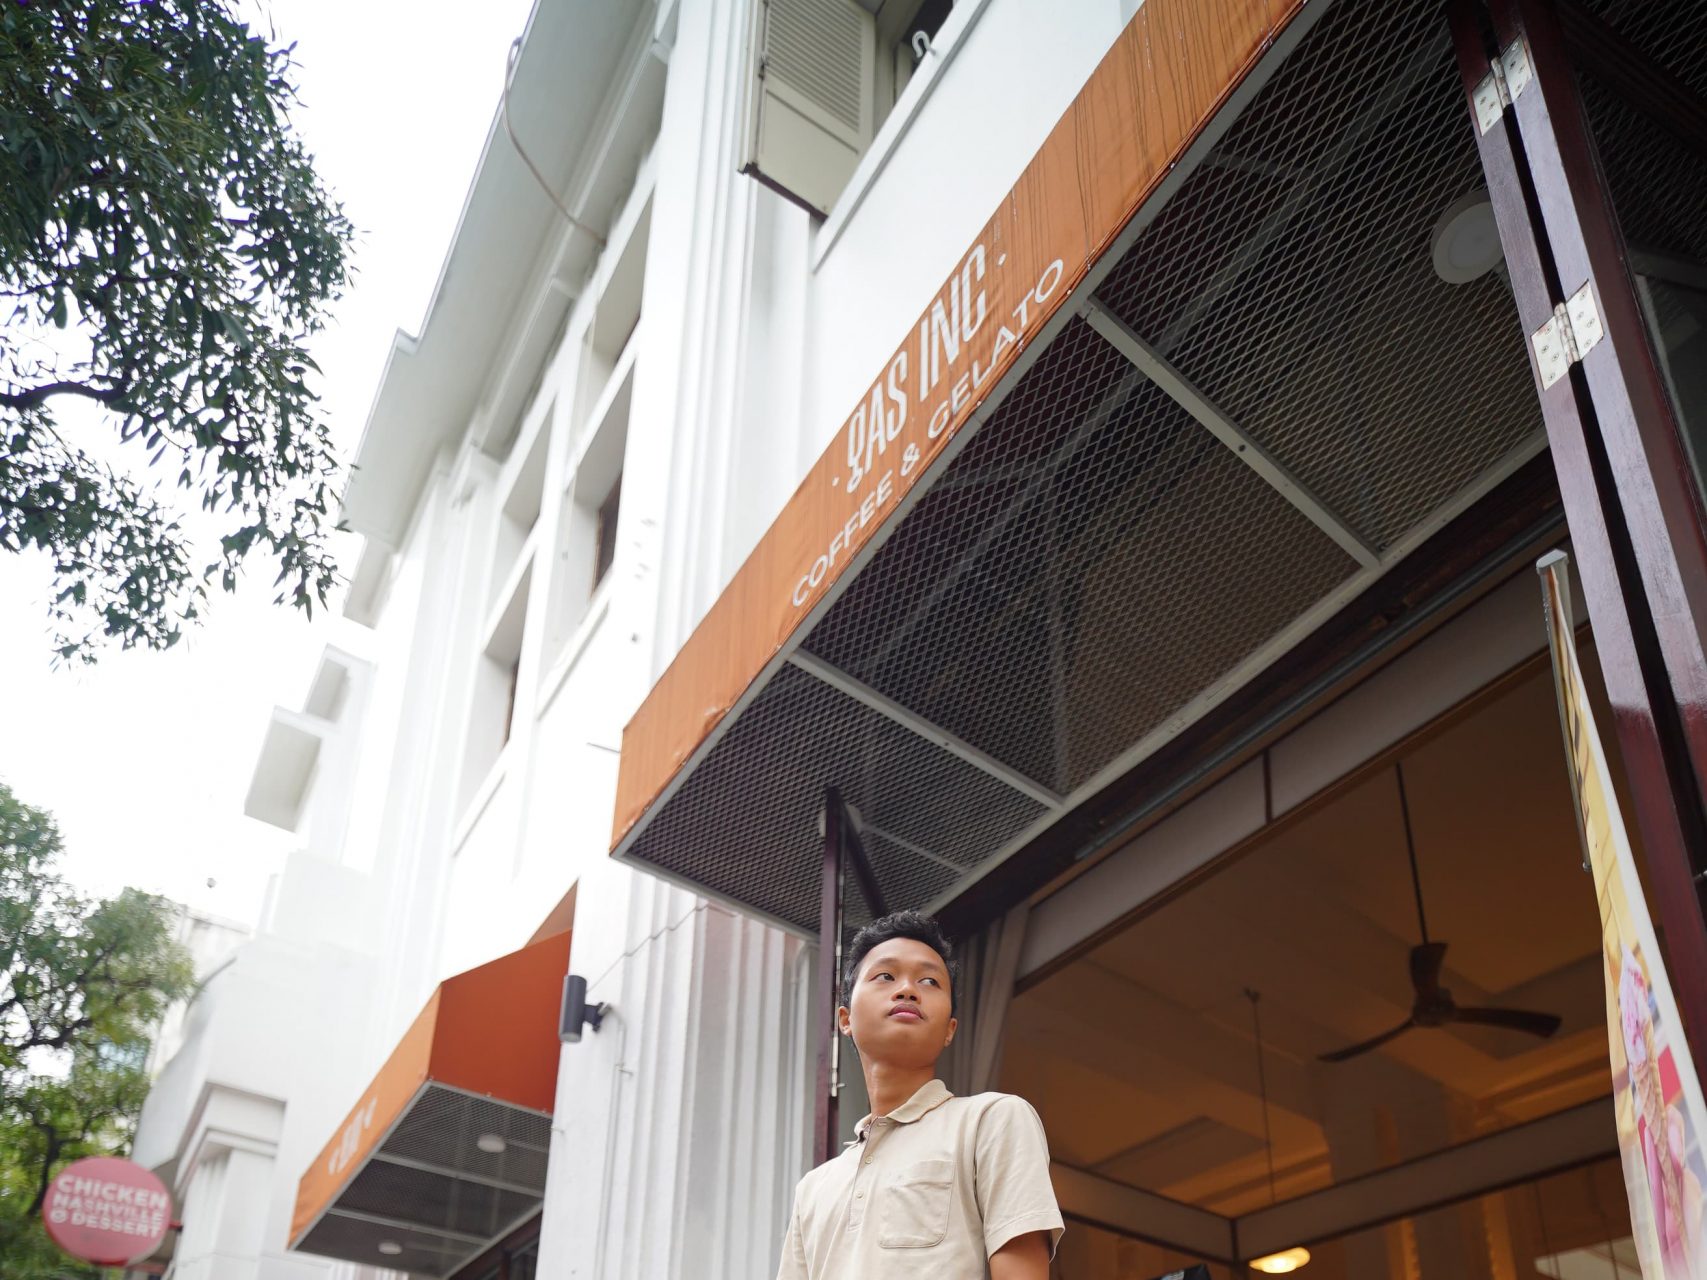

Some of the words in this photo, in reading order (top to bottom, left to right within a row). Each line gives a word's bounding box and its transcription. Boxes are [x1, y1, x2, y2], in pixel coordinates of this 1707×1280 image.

[919, 244, 987, 402] INC
[792, 470, 893, 607] COFFEE
[901, 443, 920, 477] &
[928, 258, 1064, 438] GELATO
[53, 1193, 164, 1224] NASHVILLE
[57, 1174, 169, 1209] CHICKEN
[71, 1211, 162, 1238] DESSERT
